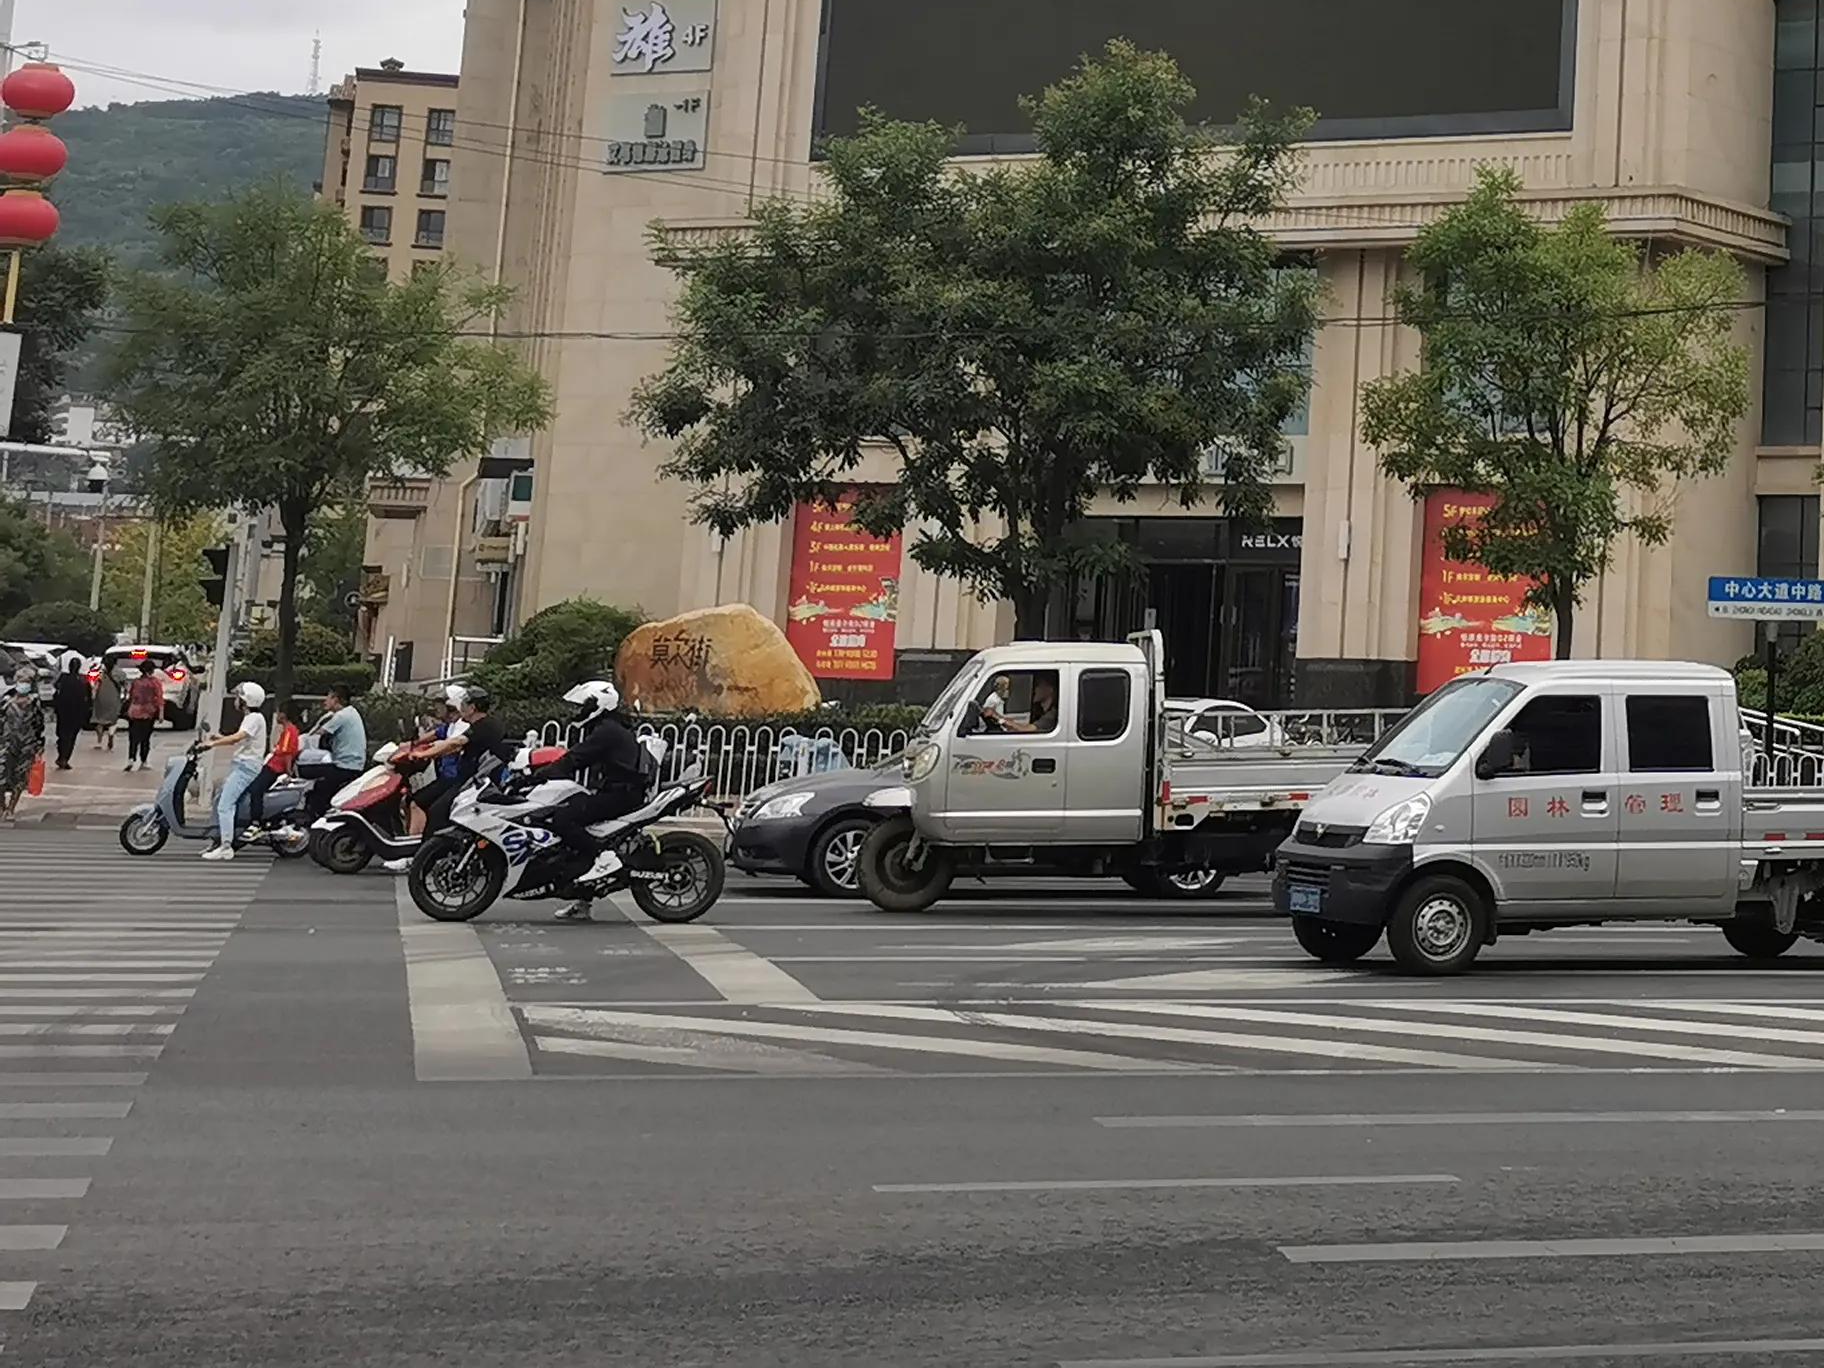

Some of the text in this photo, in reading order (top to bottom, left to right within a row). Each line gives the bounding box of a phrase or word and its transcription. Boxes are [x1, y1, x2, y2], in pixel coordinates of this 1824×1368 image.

[682, 24, 708, 47] 4F
[1242, 534, 1290, 548] RELX
[1724, 580, 1822, 600] 中心大道中路
